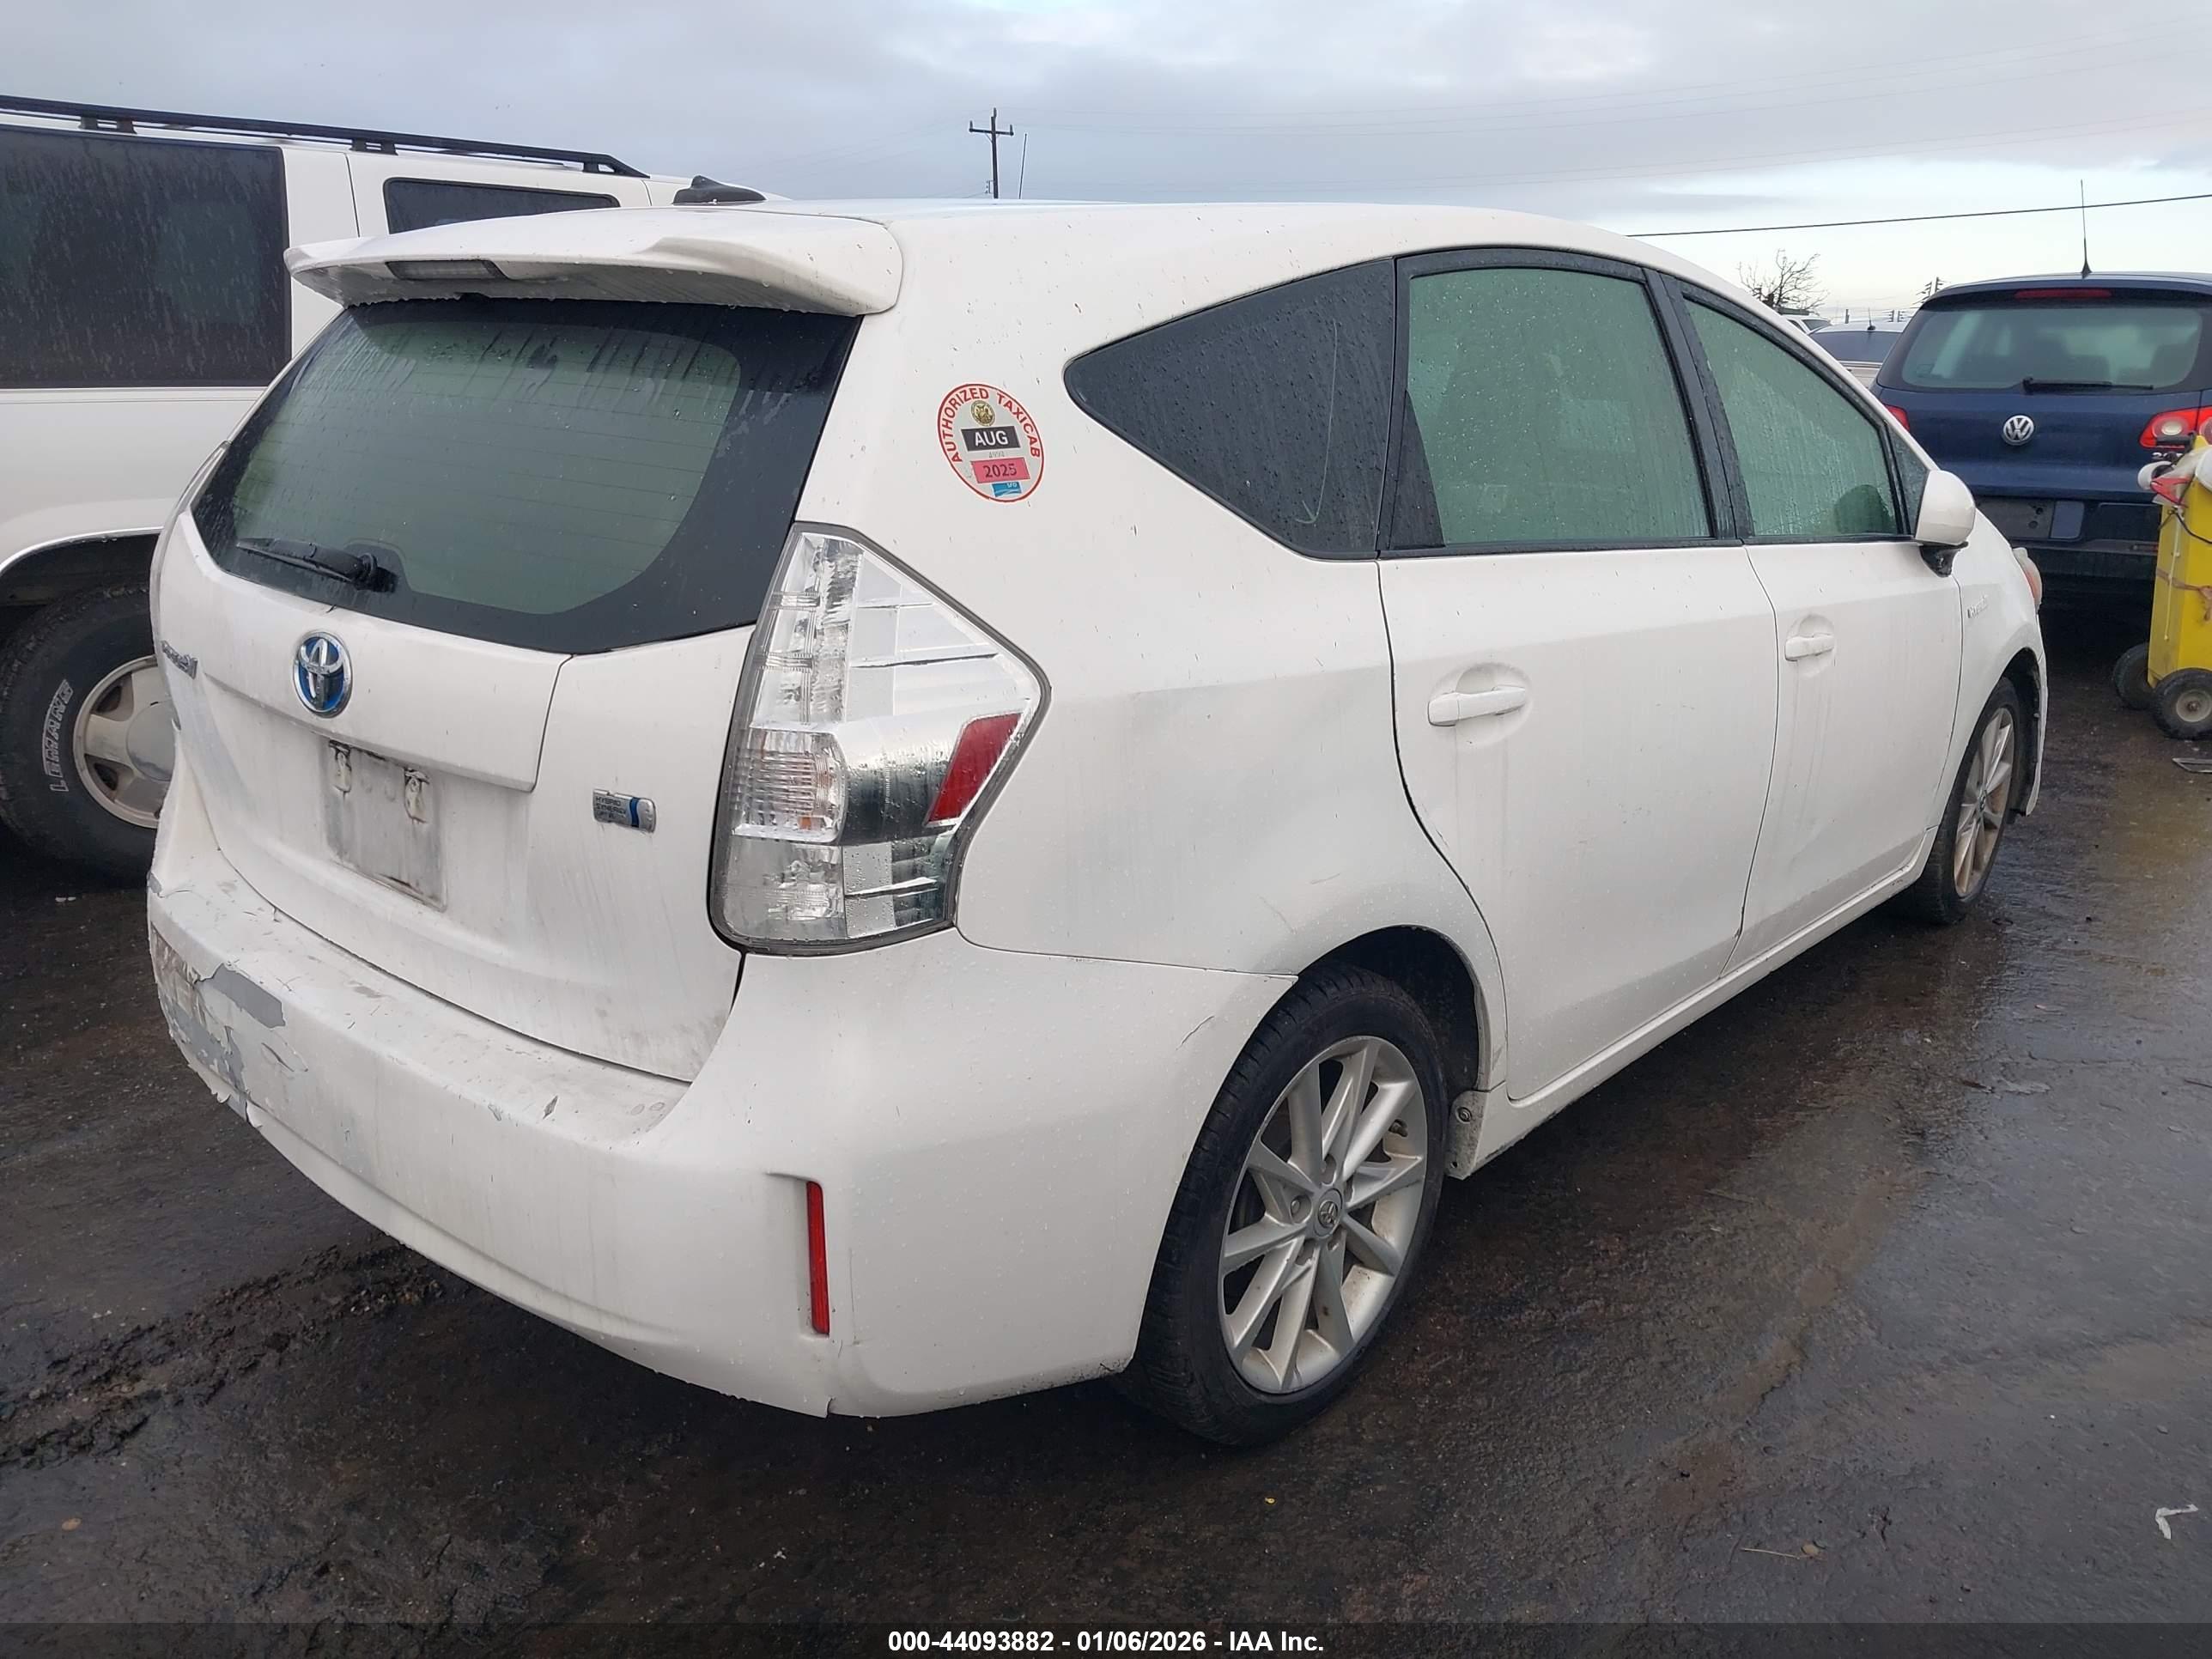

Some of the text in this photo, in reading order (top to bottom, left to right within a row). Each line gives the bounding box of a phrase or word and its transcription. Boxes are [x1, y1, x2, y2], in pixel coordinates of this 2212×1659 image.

[941, 387, 1040, 462] AUTHORIZED TAXICAB
[975, 431, 1008, 447] AUG
[982, 464, 1018, 478] 2025
